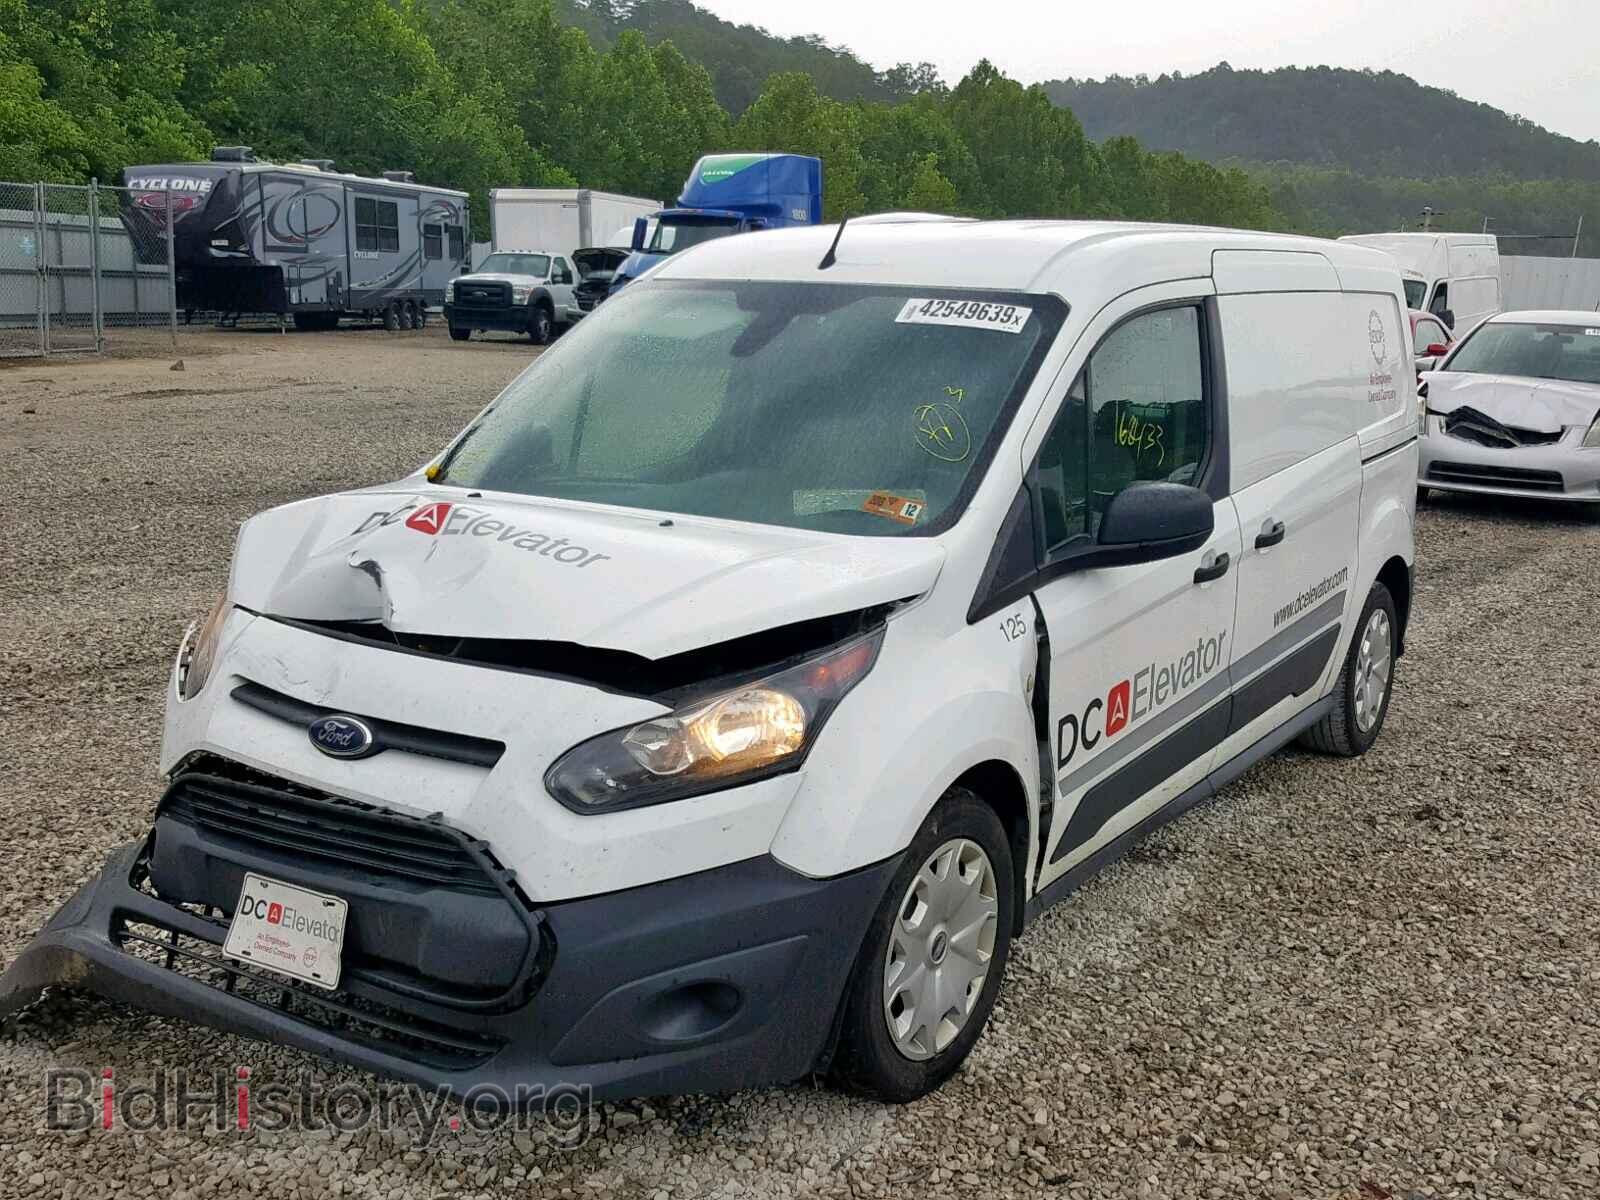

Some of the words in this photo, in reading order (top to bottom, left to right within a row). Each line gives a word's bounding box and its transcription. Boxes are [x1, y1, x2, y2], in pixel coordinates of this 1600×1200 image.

[128, 177, 212, 193] CYCLONE
[904, 503, 917, 517] 12
[441, 506, 612, 568] Elevator
[1273, 566, 1348, 629] www.dcelevator.com
[999, 613, 1026, 642] 125
[1057, 697, 1103, 772] DC
[1132, 629, 1226, 722] Elevator
[318, 720, 356, 746] Ford
[240, 895, 268, 920] DC
